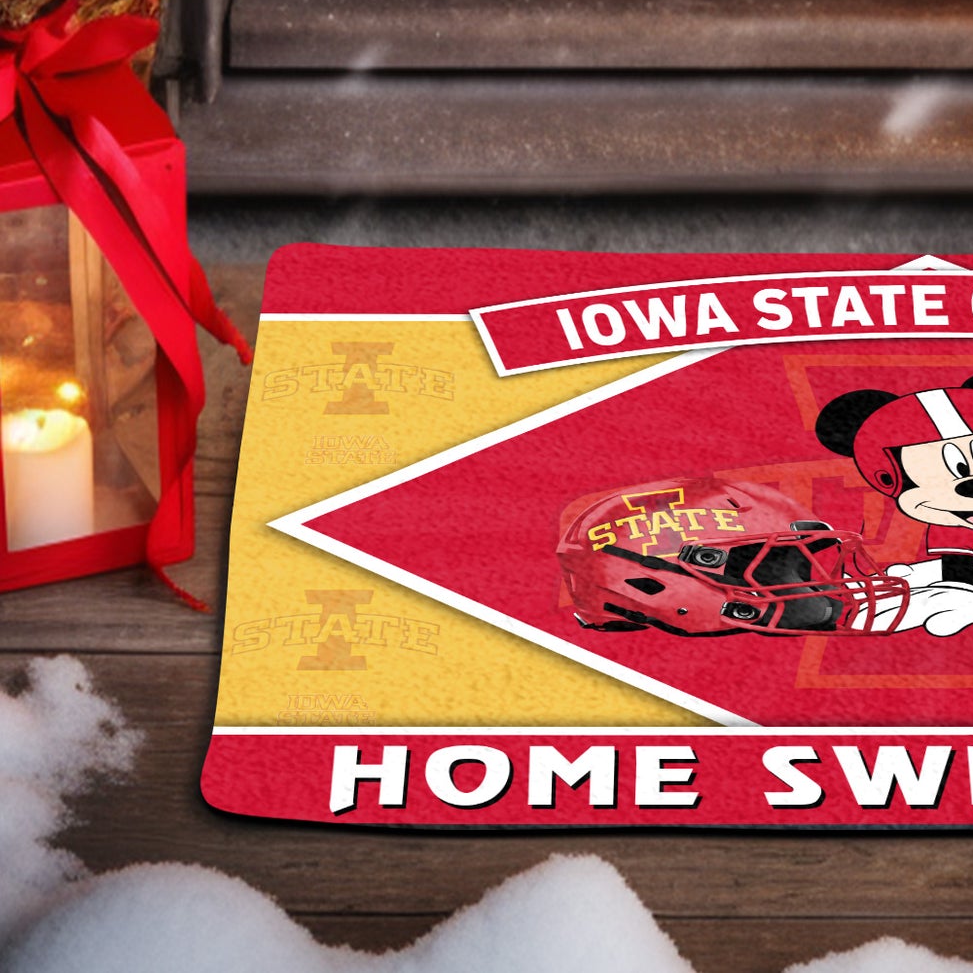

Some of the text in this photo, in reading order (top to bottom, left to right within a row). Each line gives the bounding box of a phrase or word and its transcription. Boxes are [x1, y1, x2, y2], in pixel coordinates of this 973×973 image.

[556, 292, 740, 350] IOWA
[752, 284, 950, 331] STATE
[262, 362, 455, 402] STATE
[304, 449, 397, 465] STATE
[312, 435, 390, 450] IOWA
[587, 508, 745, 551] STATE
[231, 612, 441, 656] STATE
[286, 694, 368, 710] IOWA
[329, 744, 703, 815] HOME
